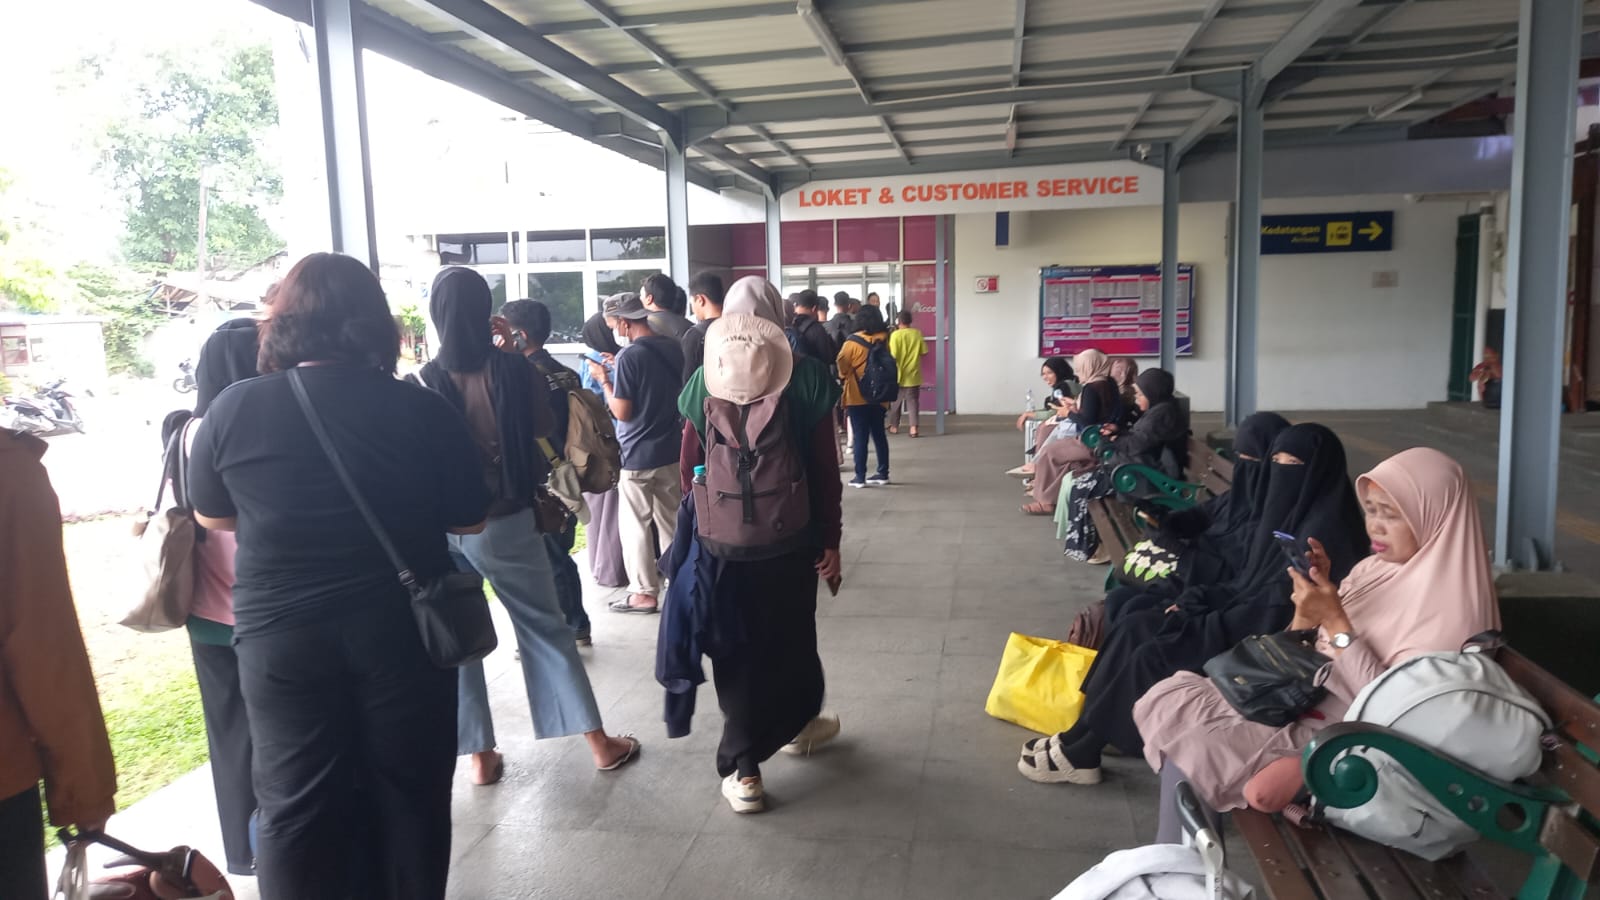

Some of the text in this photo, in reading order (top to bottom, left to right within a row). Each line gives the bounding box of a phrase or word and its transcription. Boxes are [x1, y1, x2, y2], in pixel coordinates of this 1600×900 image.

[799, 176, 1137, 207] LOKET & CUSTOMER SERVICE
